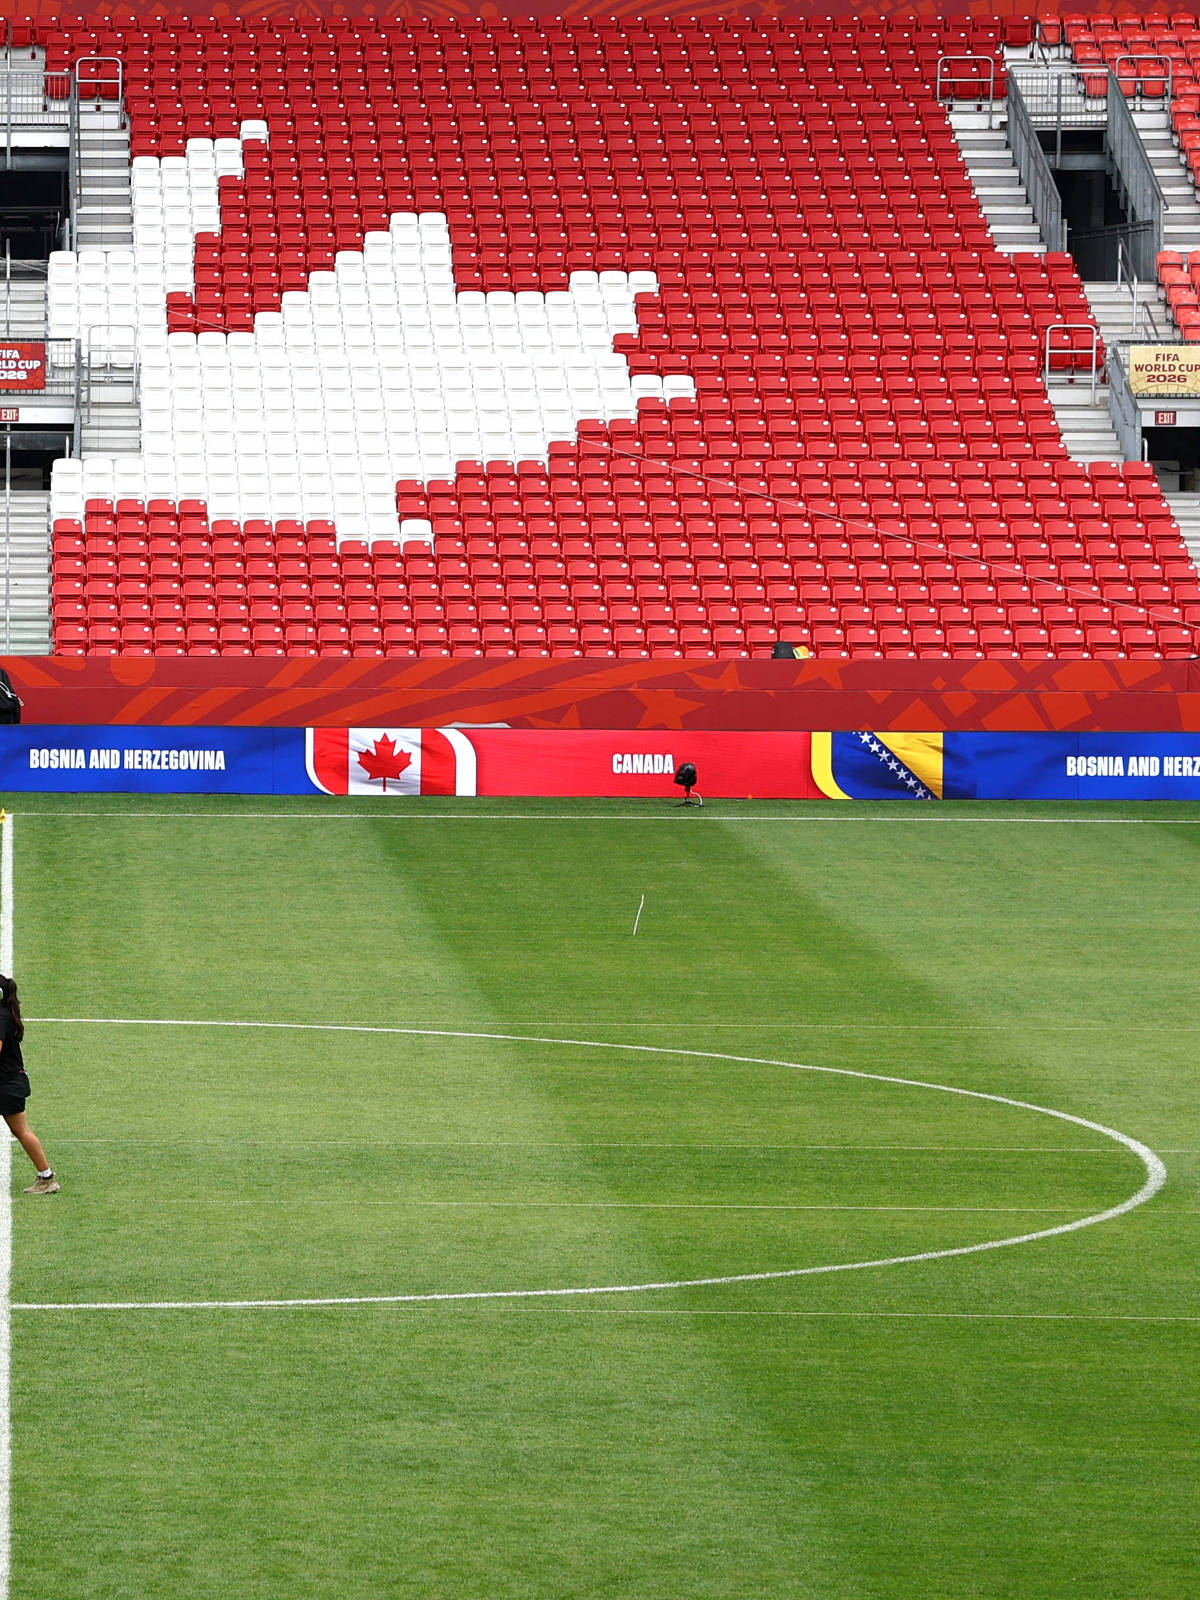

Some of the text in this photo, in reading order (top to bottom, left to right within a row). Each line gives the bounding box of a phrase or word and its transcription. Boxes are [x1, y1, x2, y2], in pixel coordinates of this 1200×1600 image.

[1155, 353, 1180, 362] FIFA
[17, 360, 41, 370] CUP
[1134, 363, 1200, 373] WORLD CUP
[1146, 374, 1188, 383] 2026
[1, 409, 17, 421] EXIT
[1158, 412, 1175, 424] EXIT
[29, 748, 226, 771] BOSNIA AND HERZEGOVINA
[612, 753, 675, 774] CANADA
[1065, 755, 1125, 777] BOSNIA
[1126, 756, 1160, 777] AND
